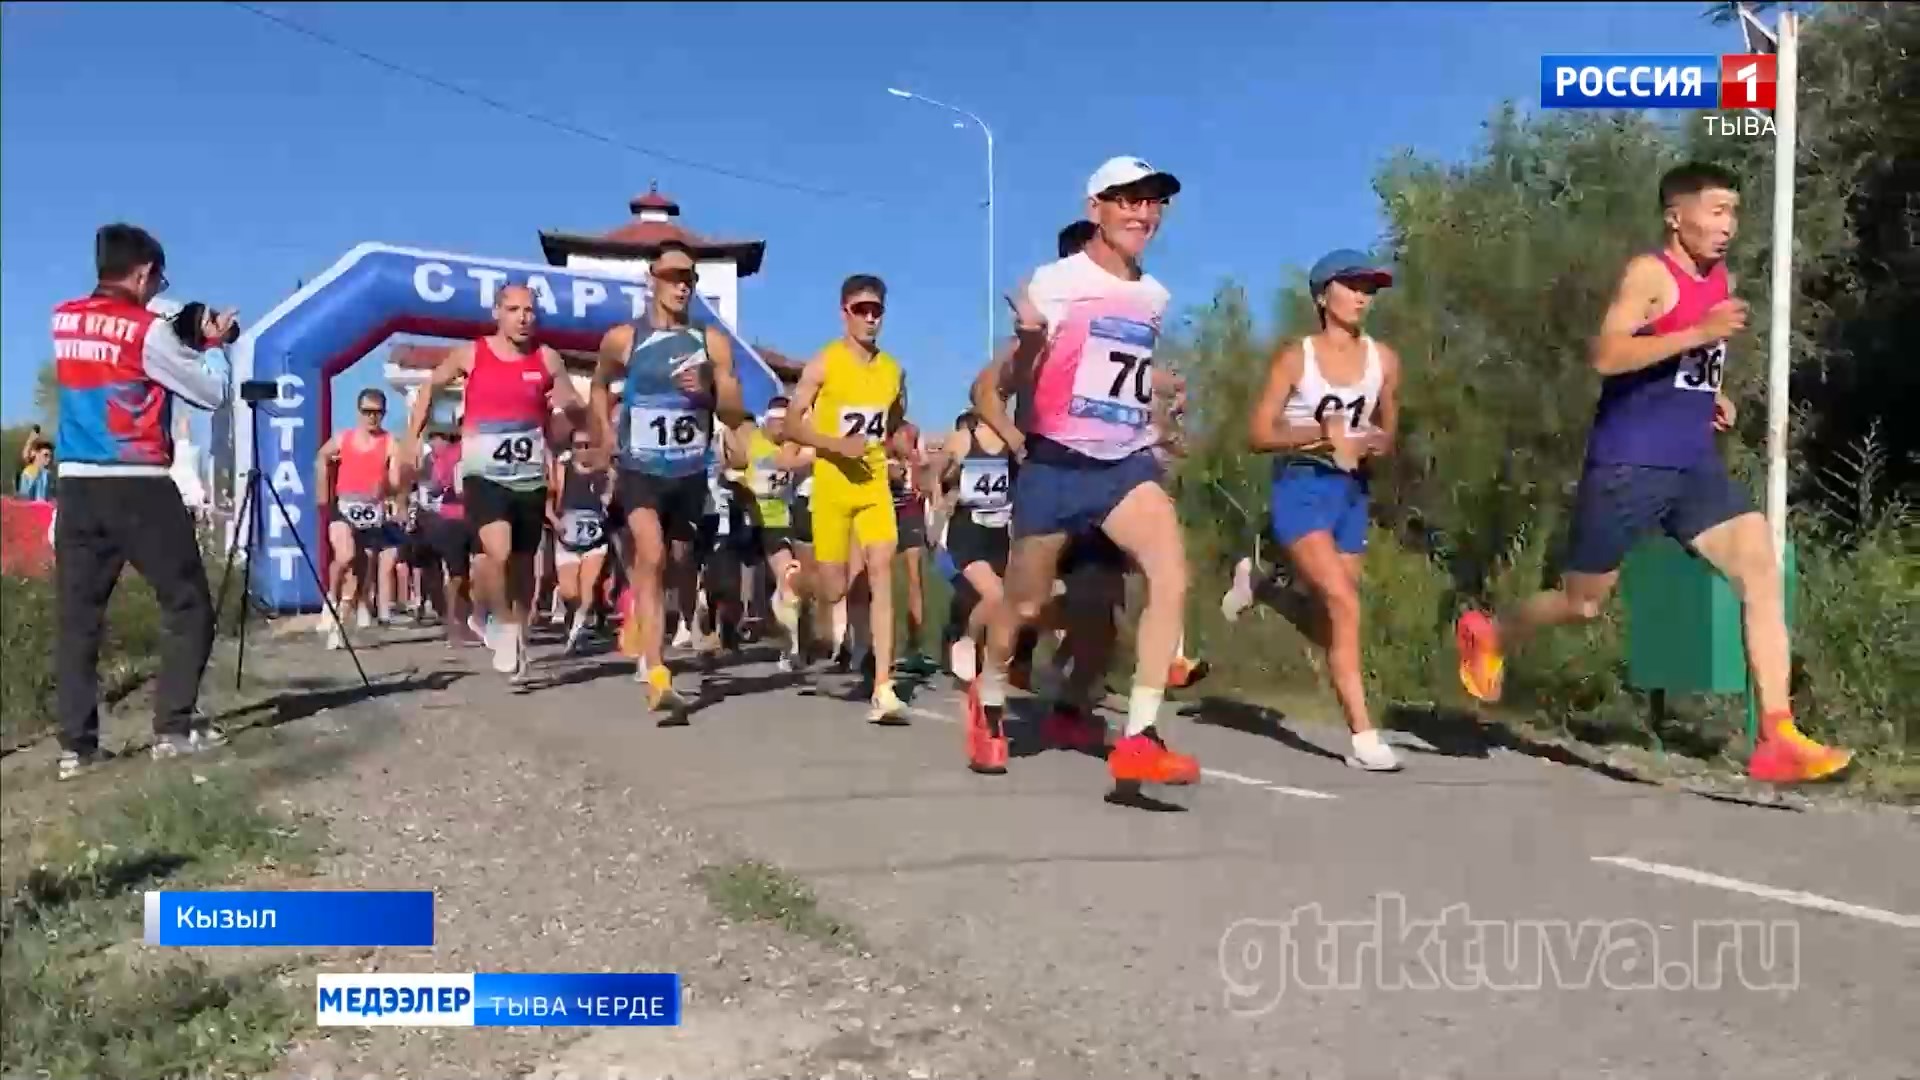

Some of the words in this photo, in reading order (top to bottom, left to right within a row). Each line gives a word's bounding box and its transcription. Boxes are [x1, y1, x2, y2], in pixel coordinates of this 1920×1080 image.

[413, 262, 653, 320] СТАРТ
[1108, 351, 1152, 404] 70
[1683, 346, 1721, 388] 36
[649, 414, 696, 447] 16
[843, 411, 885, 438] 24
[492, 436, 533, 465] 49
[269, 373, 305, 581] СТАРТ
[973, 473, 1009, 496] 44
